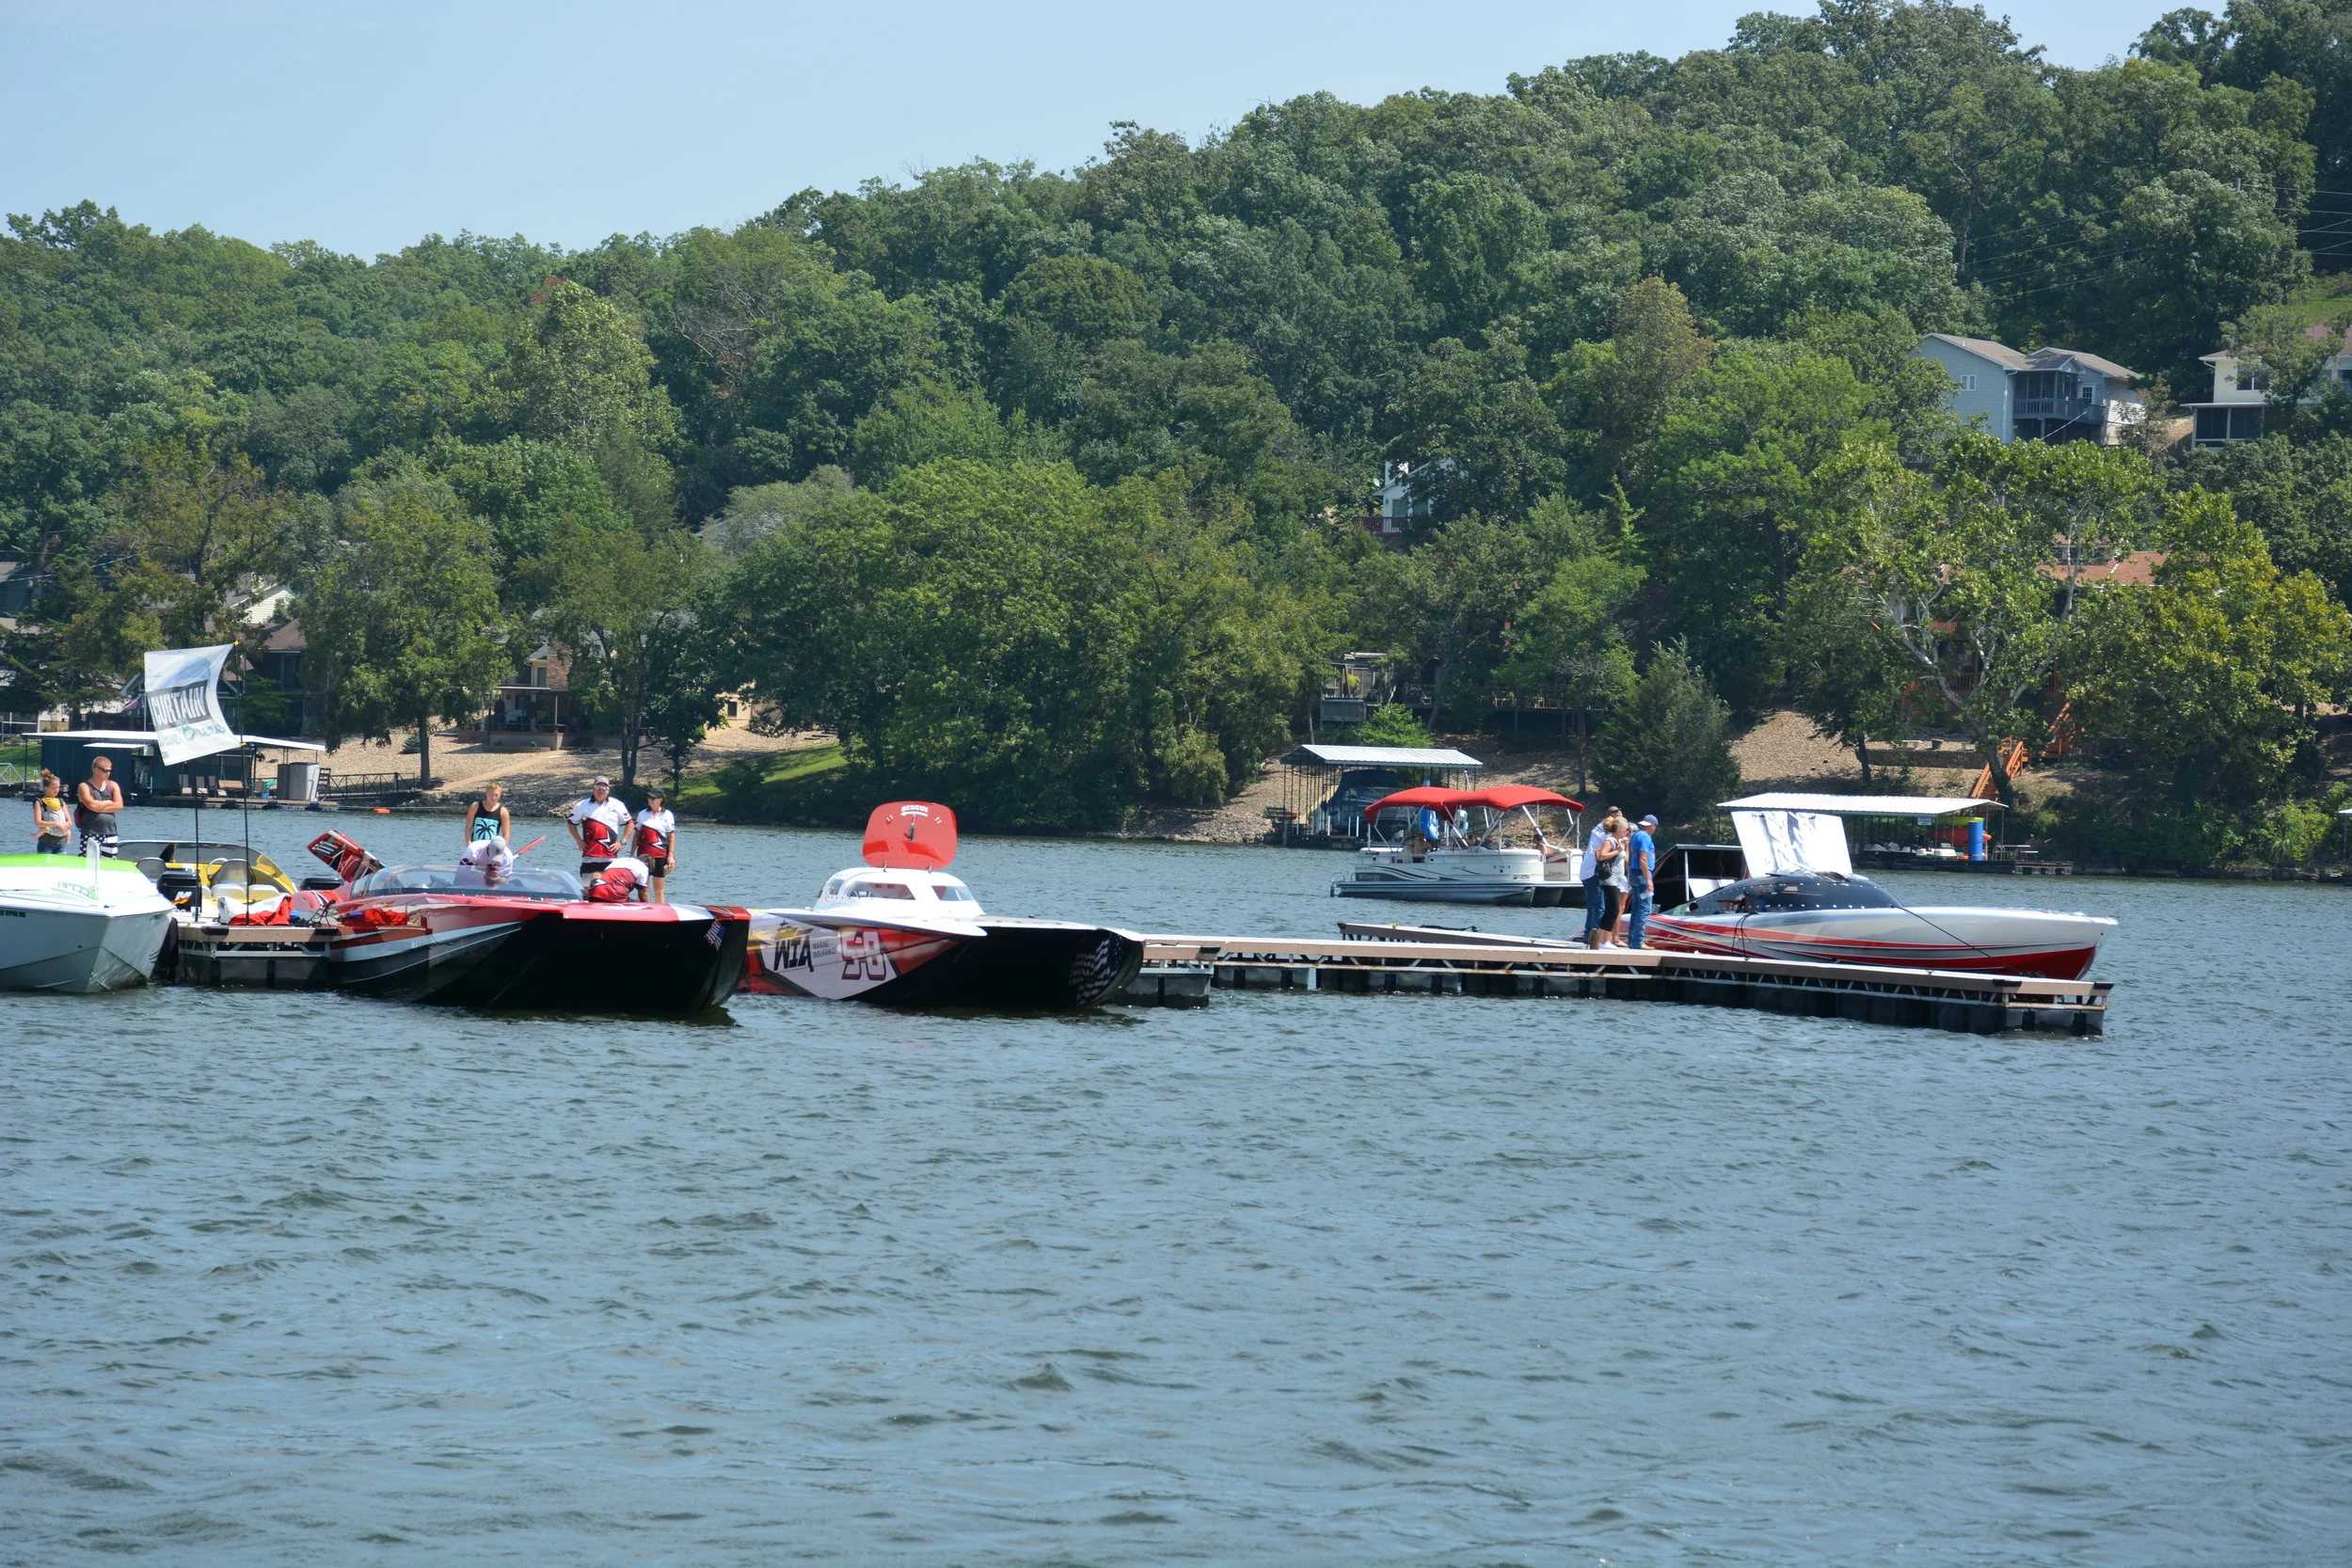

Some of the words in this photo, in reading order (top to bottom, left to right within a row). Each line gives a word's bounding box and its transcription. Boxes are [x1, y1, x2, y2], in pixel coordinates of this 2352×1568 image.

[150, 686, 207, 725] CURTAIN
[900, 804, 929, 813] RESCUE
[812, 941, 829, 949] MARINE
[773, 935, 815, 972] WIA
[812, 947, 836, 958] INSURANCE
